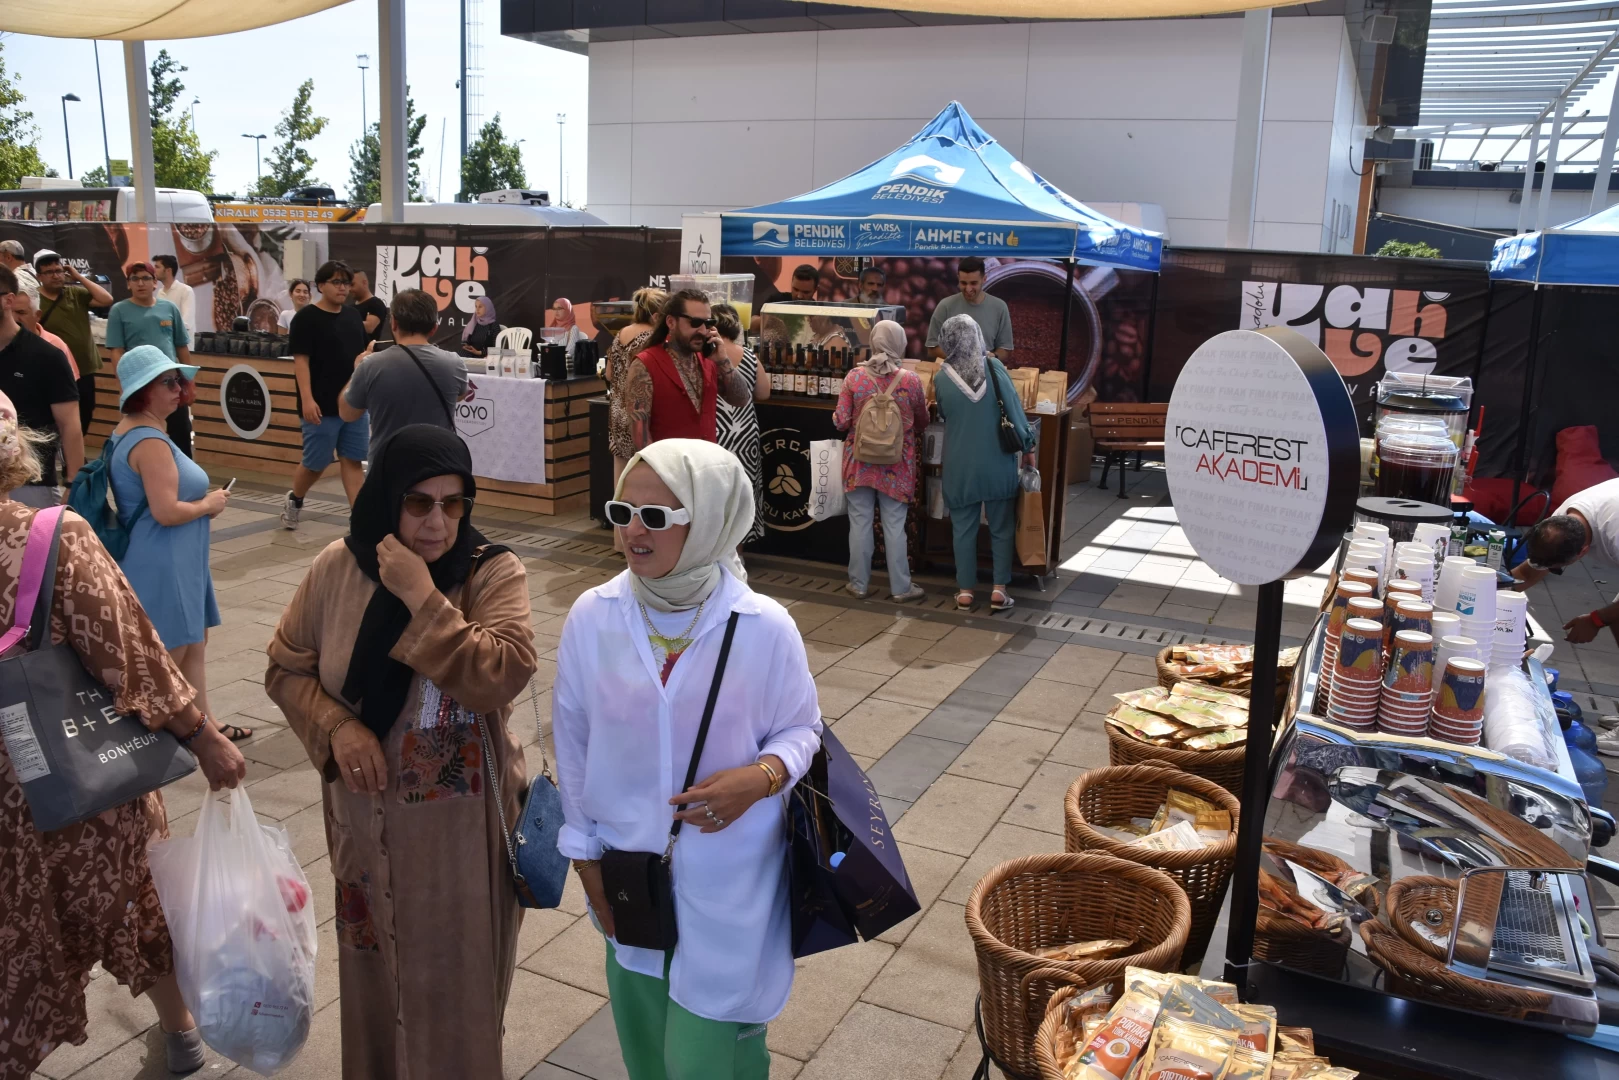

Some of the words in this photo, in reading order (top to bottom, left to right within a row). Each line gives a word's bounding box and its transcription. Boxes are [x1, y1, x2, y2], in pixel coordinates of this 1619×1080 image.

[876, 184, 949, 198] PENDİK
[871, 193, 944, 204] BELEDİYESİ
[794, 224, 844, 238] PENDİK
[873, 223, 900, 232] VARSA
[794, 239, 846, 248] BELEDİYESİ
[915, 228, 972, 244] AHMET
[976, 232, 1004, 246] CİN
[1117, 416, 1160, 424] PENDİK
[762, 439, 811, 460] ERCA
[814, 450, 829, 516] DeFacto
[76, 688, 103, 705] TH
